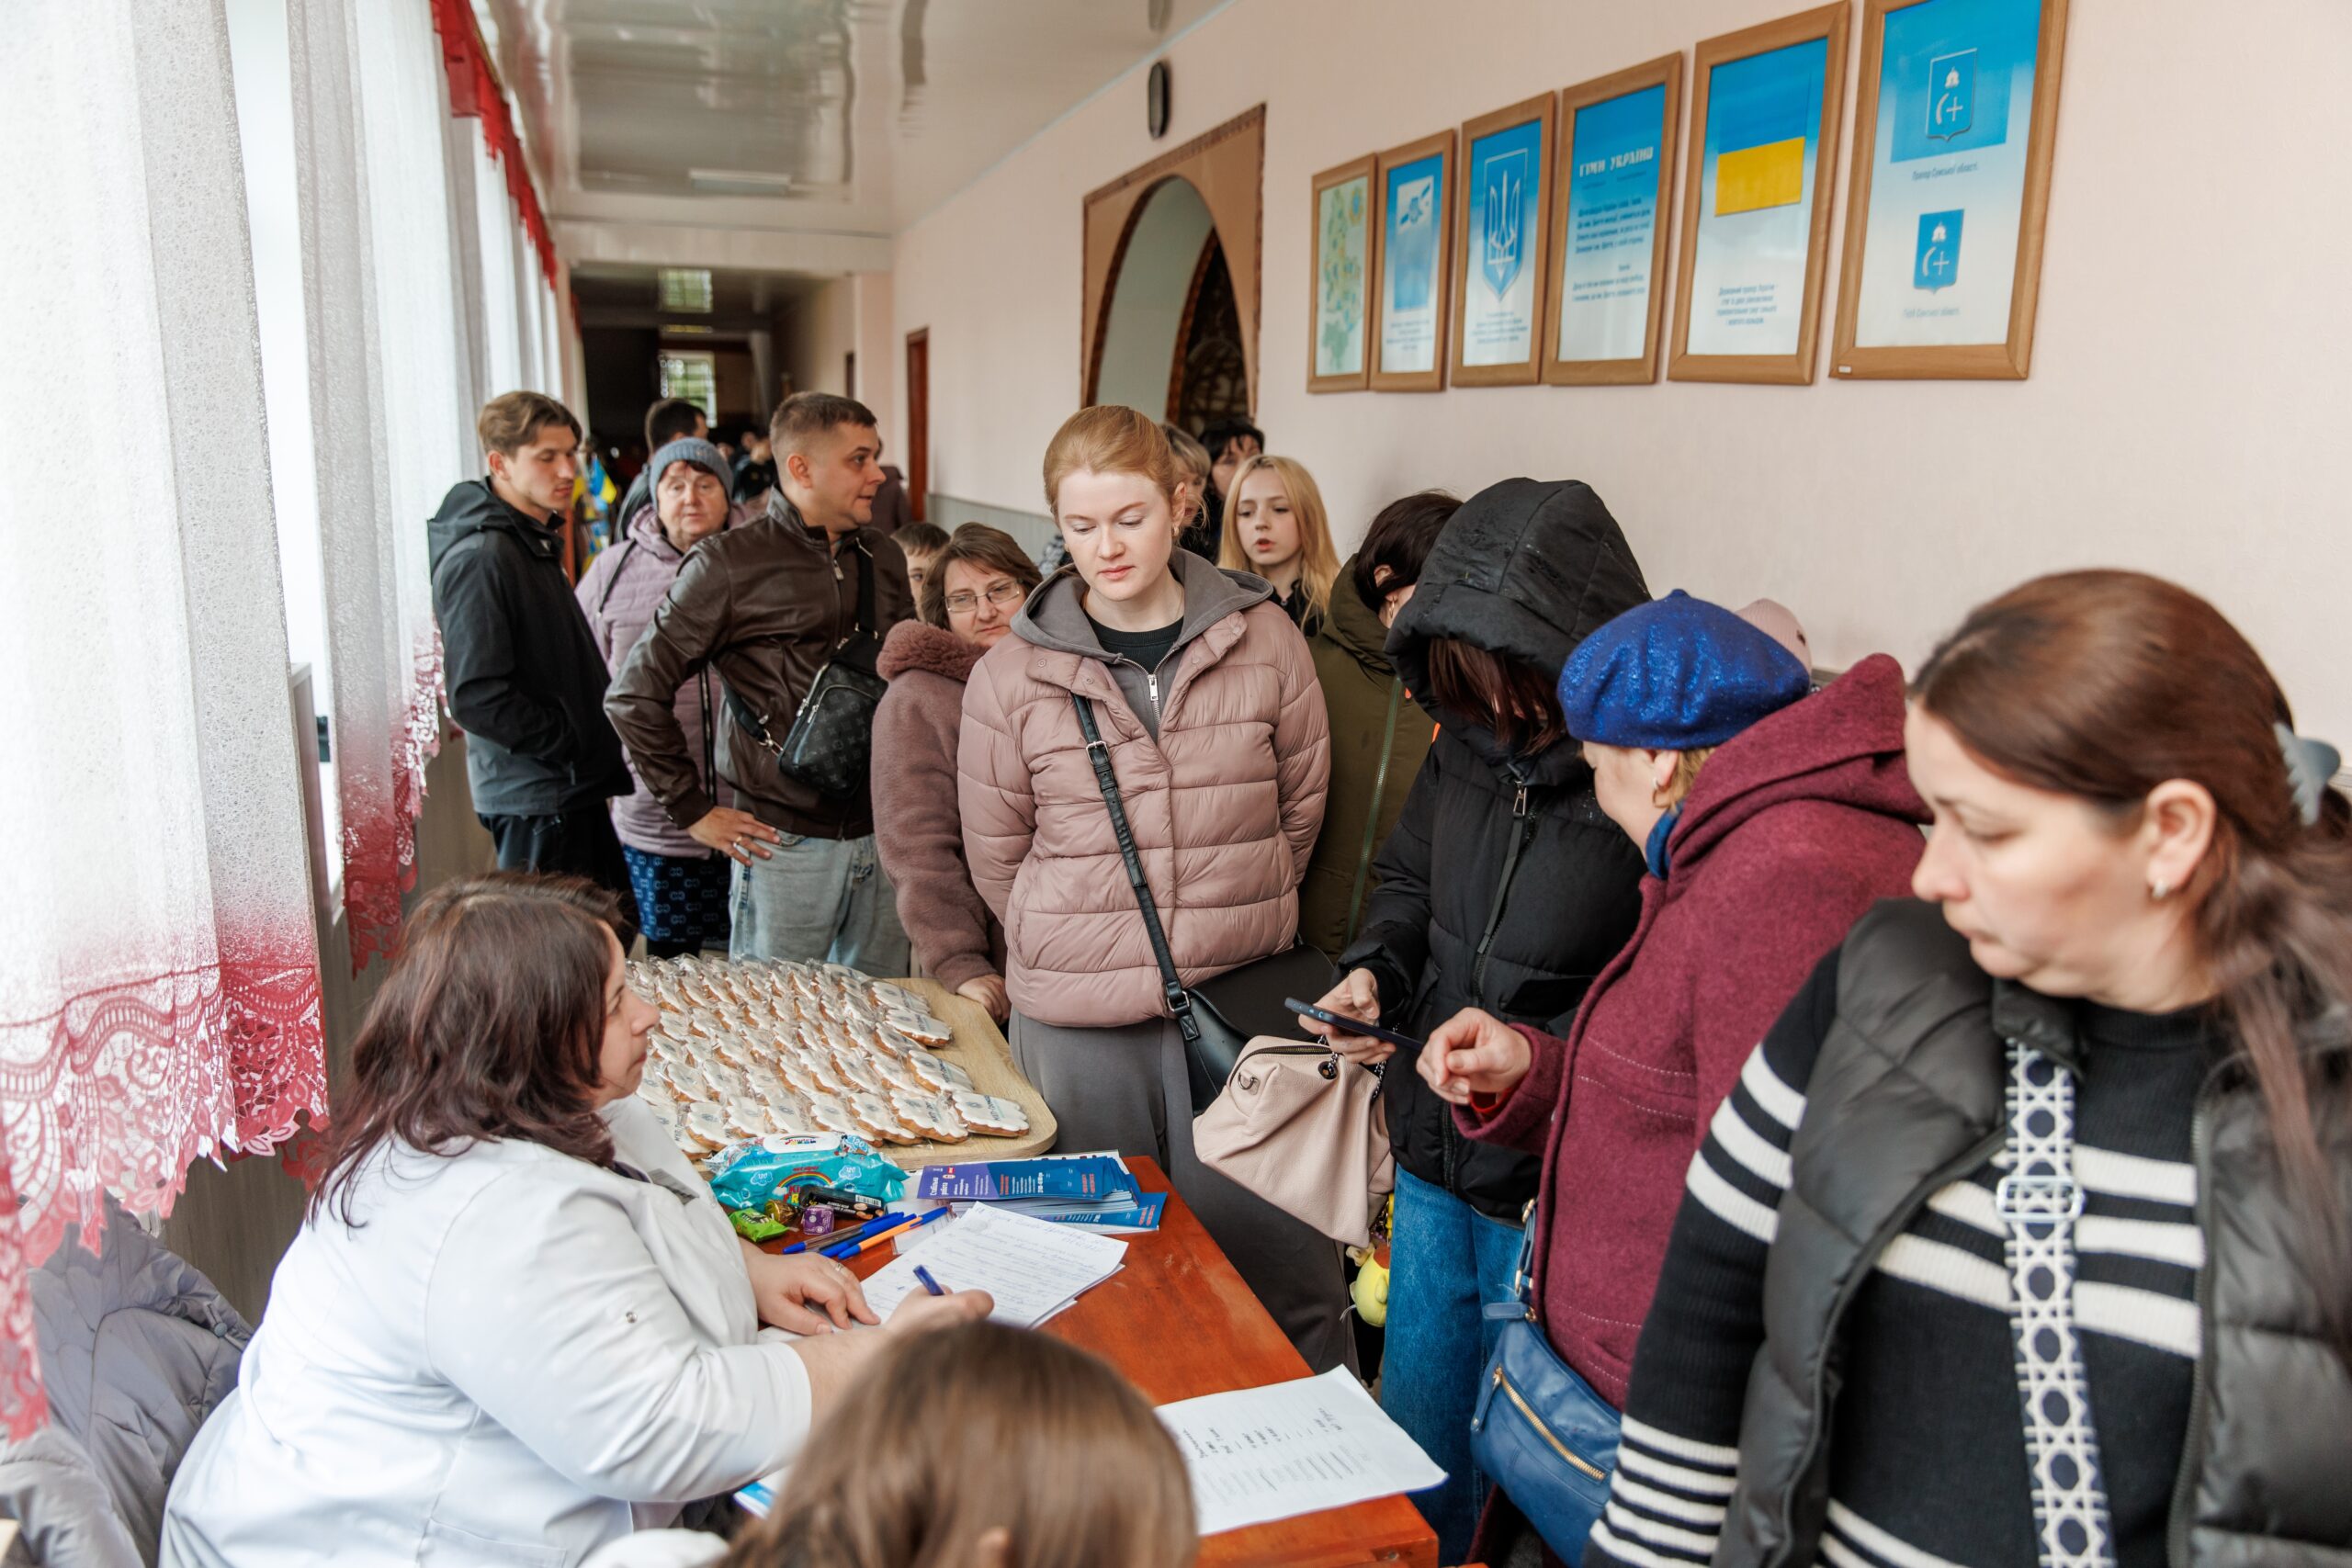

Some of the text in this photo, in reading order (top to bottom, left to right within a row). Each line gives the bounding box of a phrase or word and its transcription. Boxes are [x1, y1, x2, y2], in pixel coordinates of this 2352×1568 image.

[1579, 146, 1654, 177] ГІМН УКРАЇНИ
[852, 1136, 865, 1148] 120
